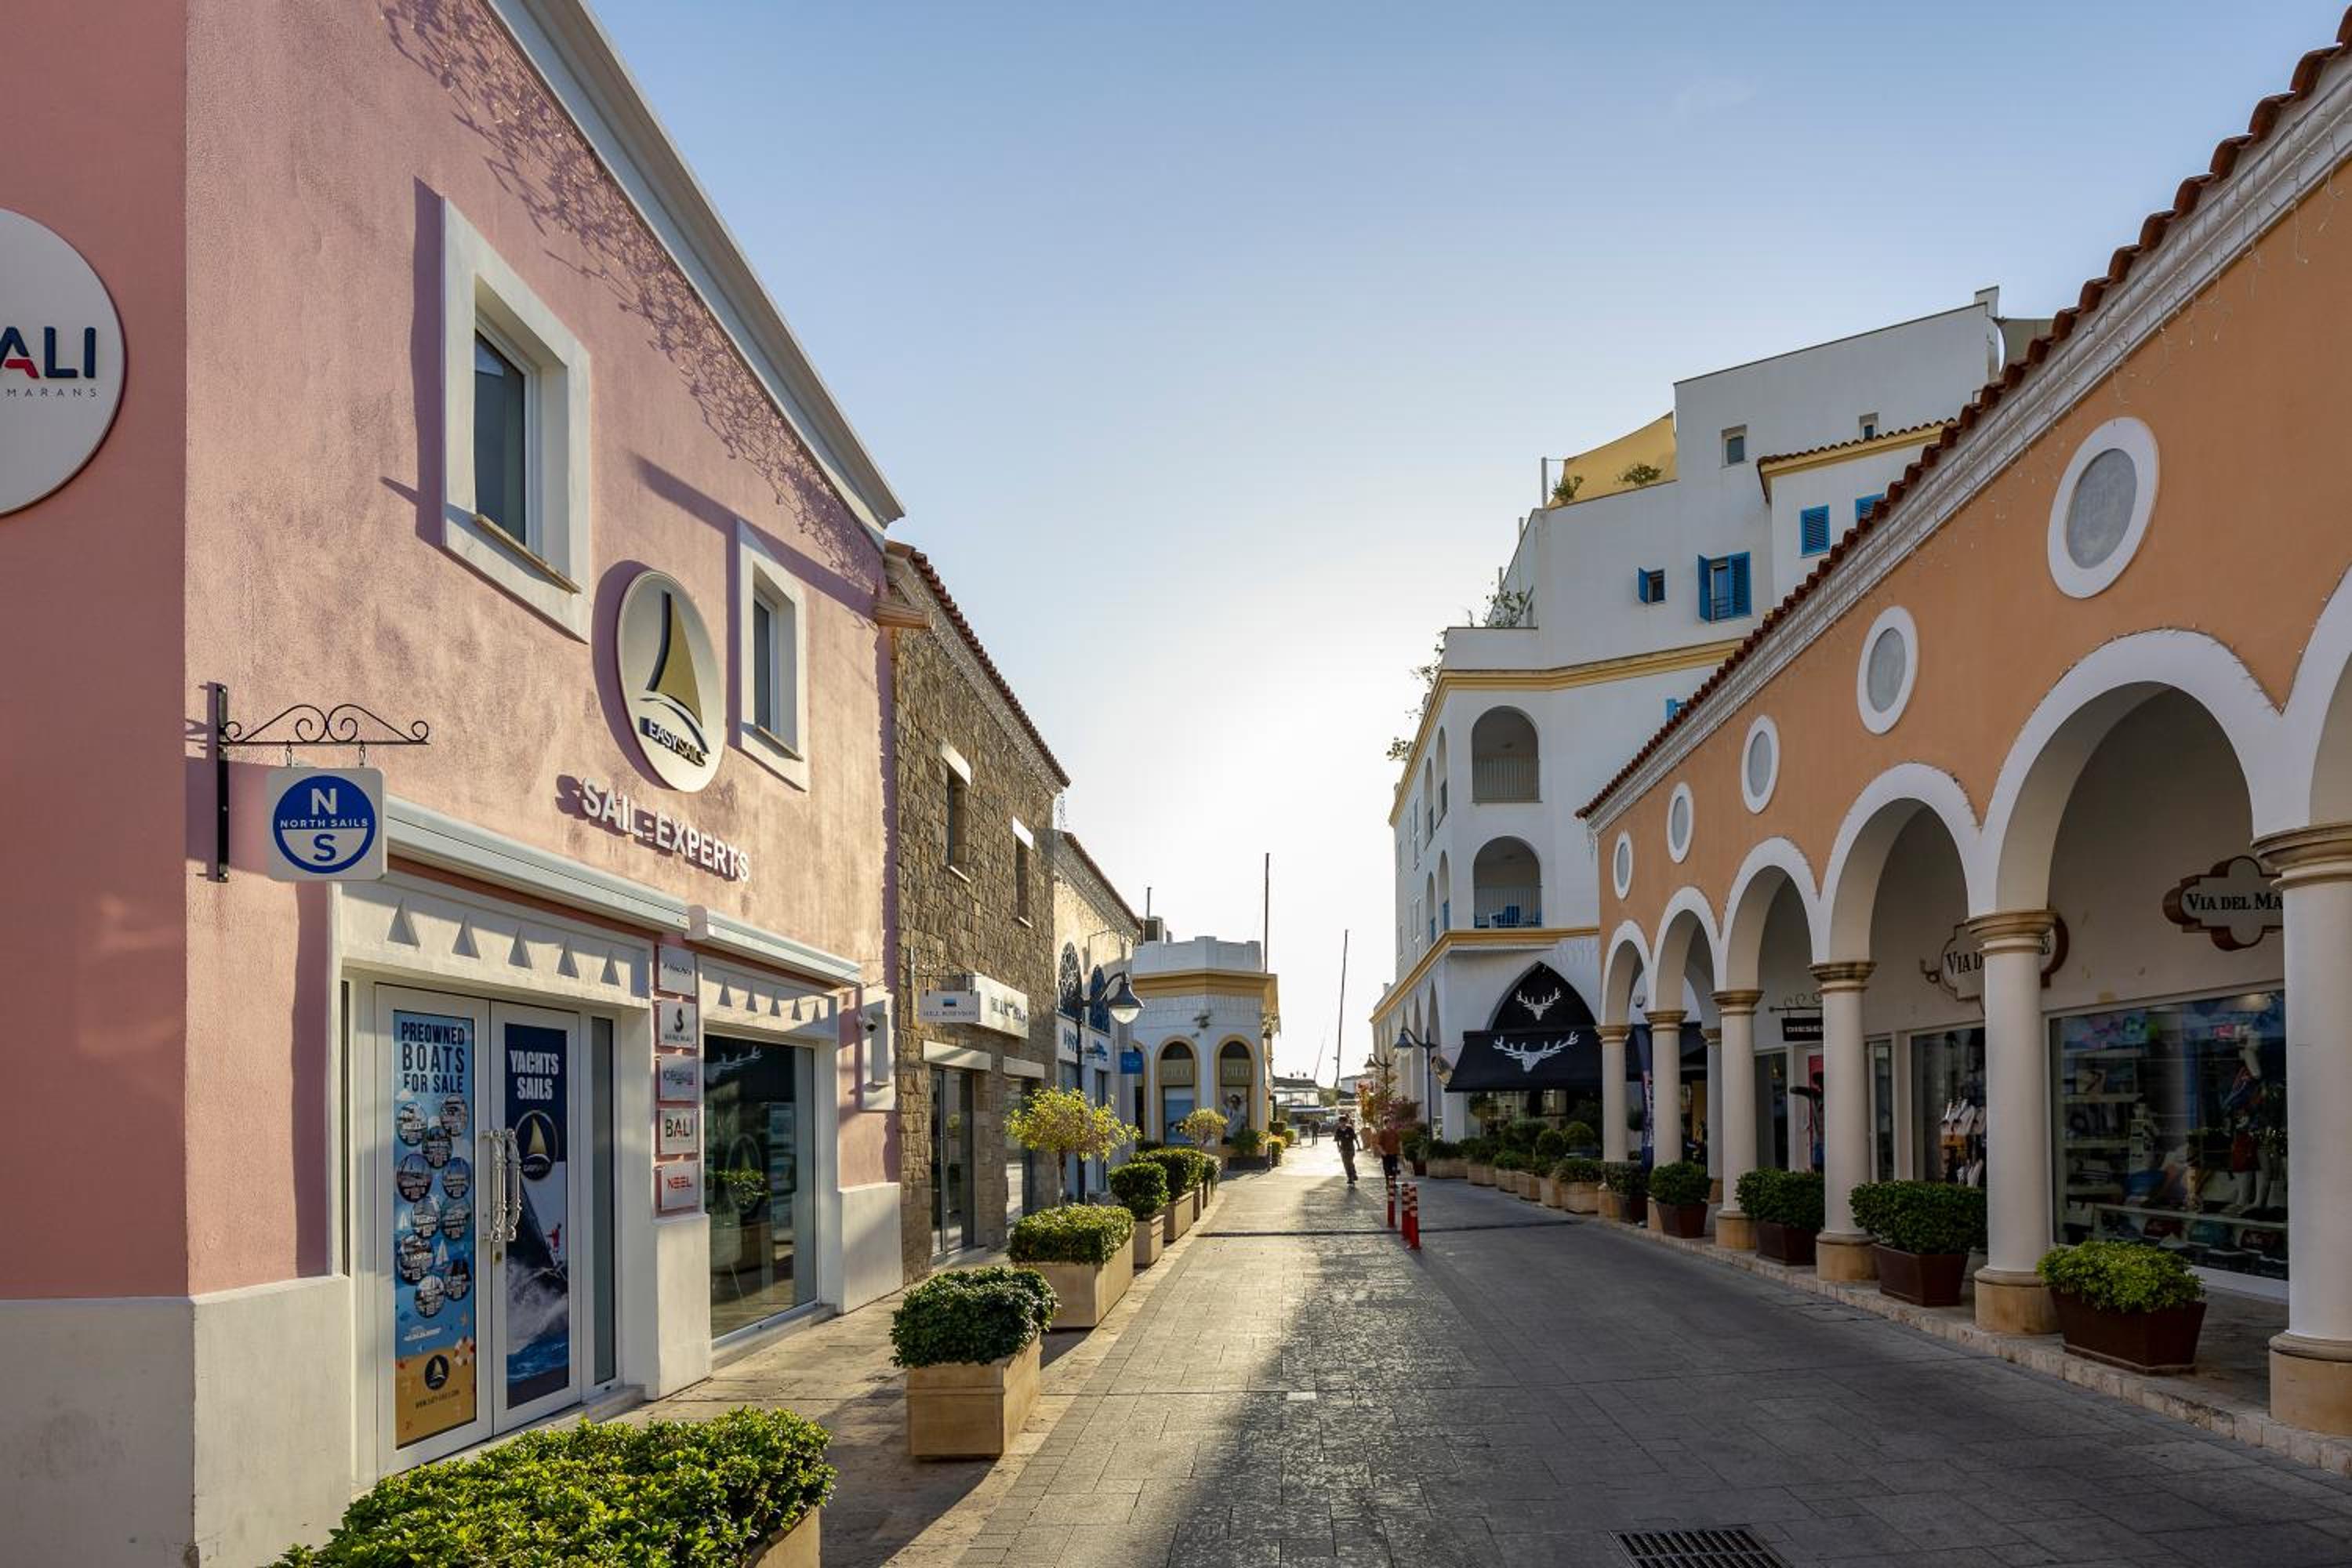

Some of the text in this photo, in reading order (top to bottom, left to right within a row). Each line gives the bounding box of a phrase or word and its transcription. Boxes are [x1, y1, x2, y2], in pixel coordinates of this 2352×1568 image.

[0, 326, 96, 379] ALI
[7, 388, 97, 397] MARANS
[311, 787, 337, 815] N
[280, 818, 368, 829] NORTH SAILS
[314, 833, 337, 862] S
[2255, 892, 2283, 910] MA
[401, 1022, 465, 1045] PREOWNED
[1786, 1025, 1824, 1033] DIESE
[402, 1043, 465, 1073] BOATS
[510, 1050, 559, 1075] YACHTS
[404, 1073, 463, 1094] FOR SALE
[517, 1076, 553, 1100] SAILS
[666, 1119, 694, 1138] BALI
